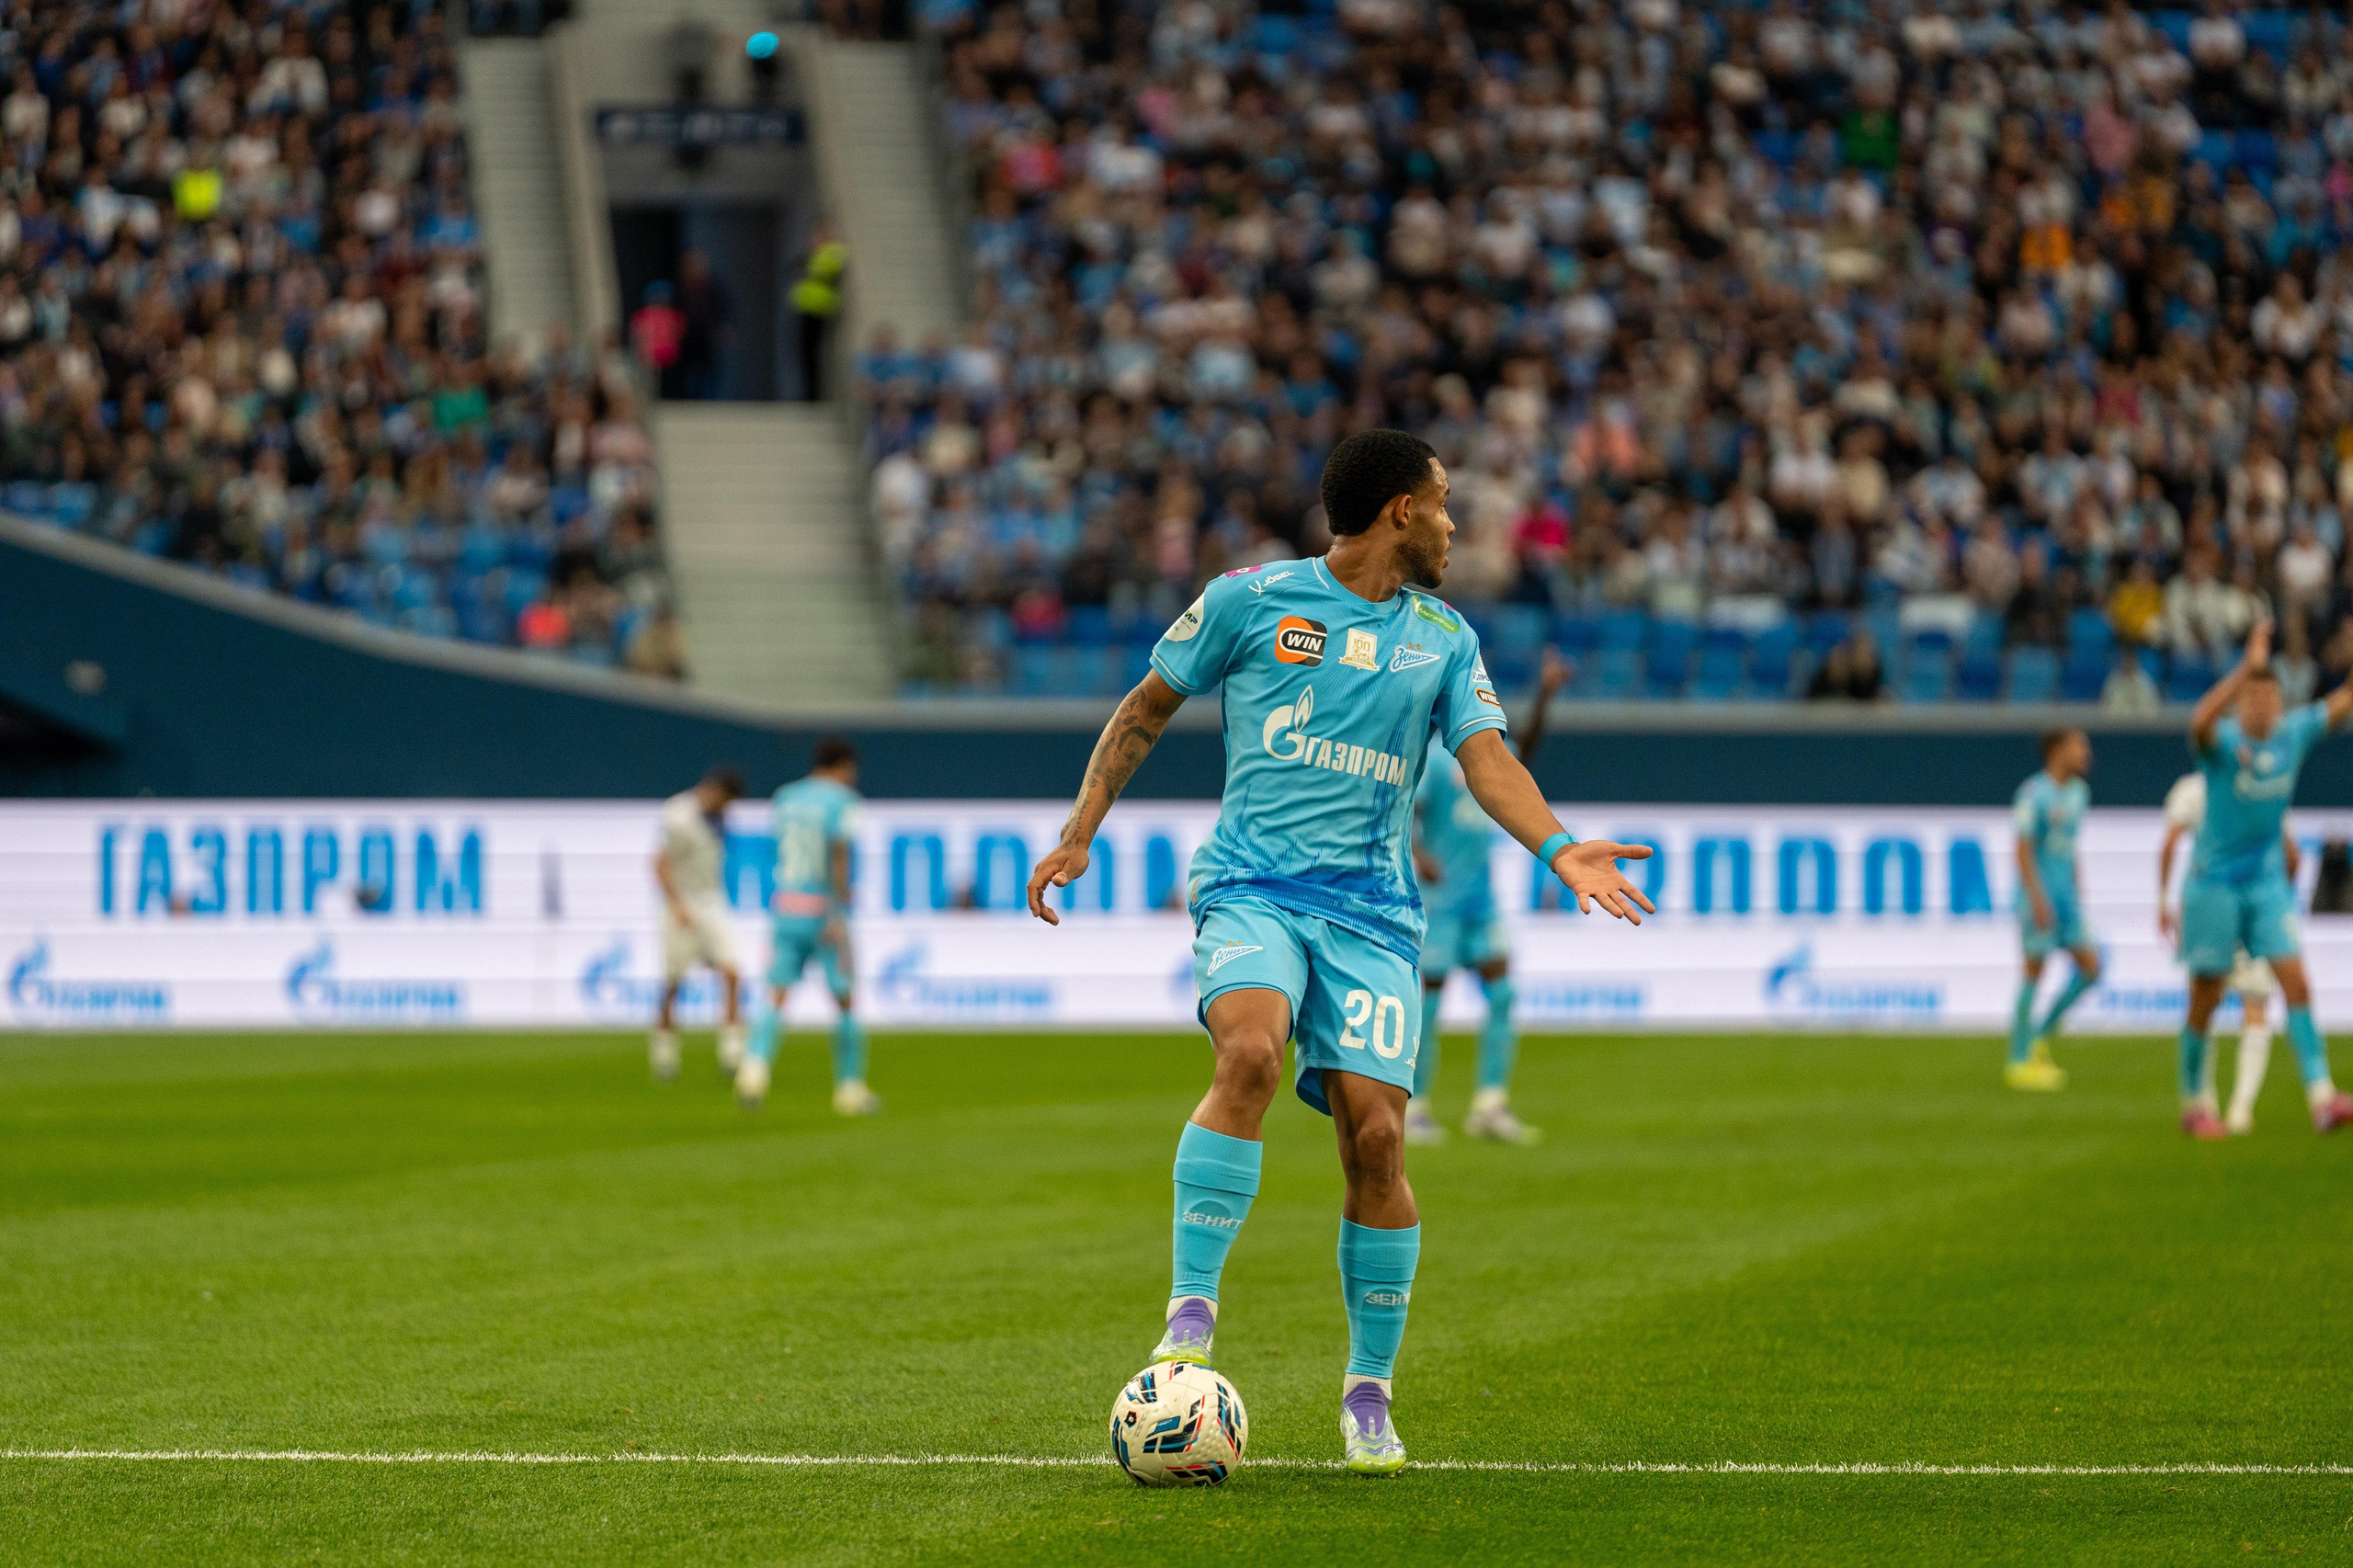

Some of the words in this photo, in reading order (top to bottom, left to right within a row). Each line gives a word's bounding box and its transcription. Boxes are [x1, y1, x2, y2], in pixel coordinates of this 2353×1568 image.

[1264, 571, 1294, 586] JÖGEL
[1418, 608, 1454, 631] МЕГАФОН
[1287, 633, 1323, 652] WIN
[1392, 647, 1429, 670] Зенит
[1479, 691, 1499, 704] WINL
[1303, 736, 1407, 788] ГАЗПРОМ
[99, 822, 484, 915] ГАЗПРОМ
[1338, 989, 1405, 1059] 20
[1182, 1210, 1245, 1231] ЗЕНИТ
